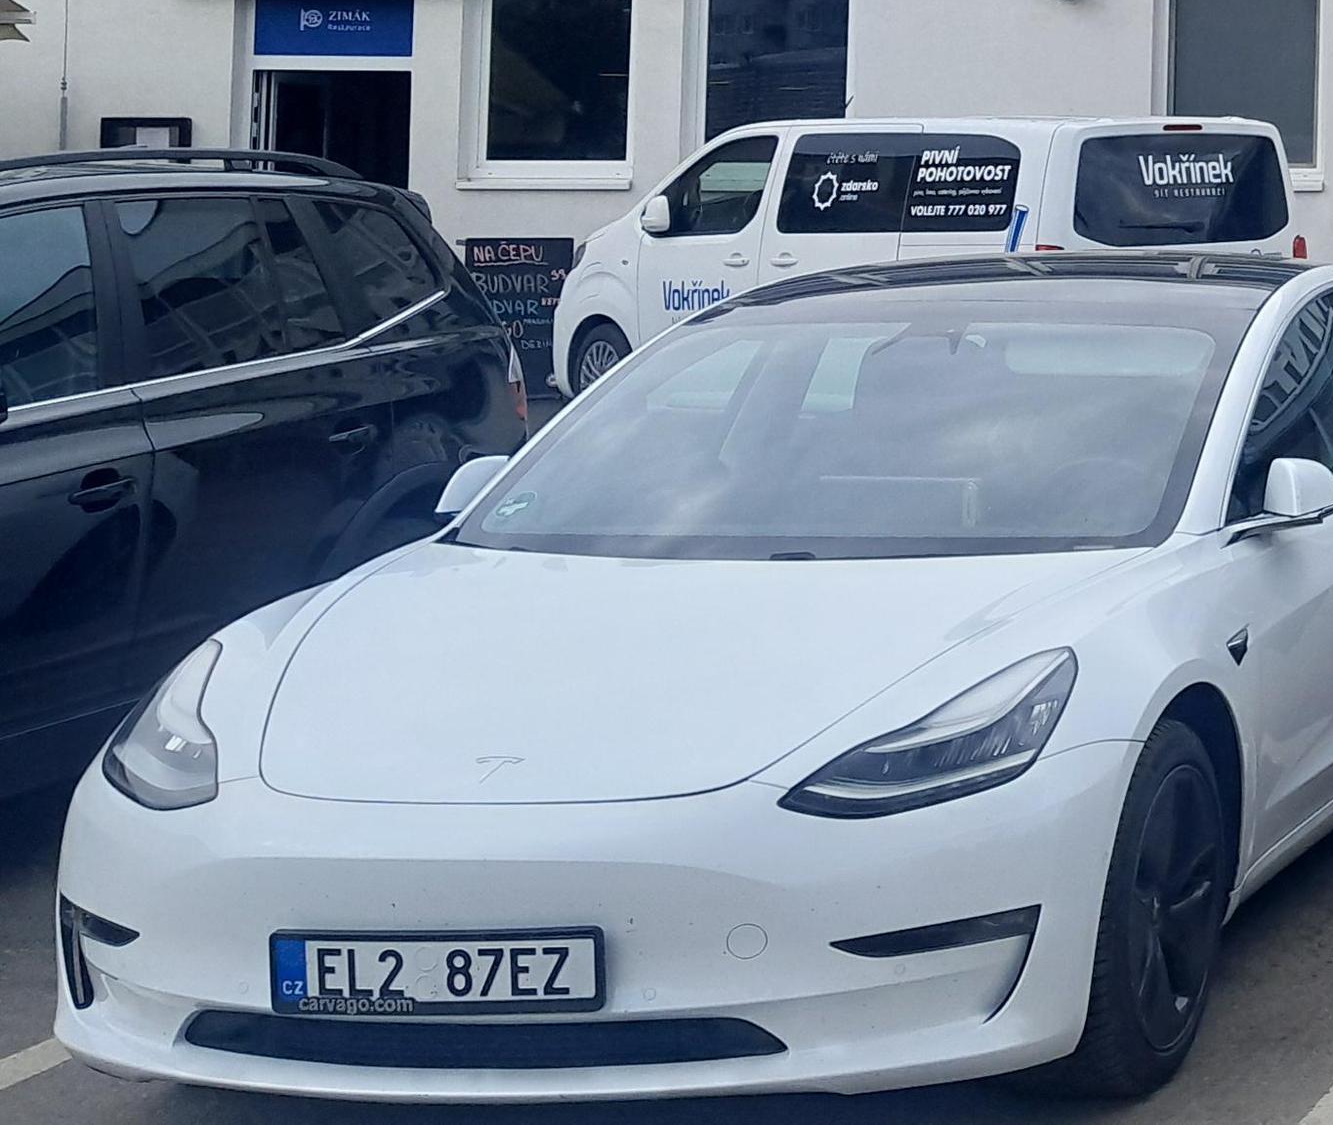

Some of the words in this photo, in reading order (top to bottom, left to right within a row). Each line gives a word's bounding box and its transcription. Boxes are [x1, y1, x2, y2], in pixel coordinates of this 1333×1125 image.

[328, 9, 371, 22] ZIMÁK
[921, 146, 960, 165] PIVNÍ
[917, 165, 1011, 182] POHOTOVOST
[1138, 153, 1234, 186] Vokřínek
[910, 205, 946, 216] VOLEJTE
[948, 204, 966, 216] 777
[967, 204, 986, 216] 020
[988, 204, 1007, 215] 977
[473, 245, 495, 262] NA
[500, 241, 544, 262] ČEPU
[473, 272, 549, 294] BUDVAR
[662, 279, 731, 311] Vokřínek
[493, 299, 539, 316] DVAR
[317, 947, 405, 997] EL2
[446, 945, 571, 998] 87EZ
[282, 981, 305, 995] CZ
[299, 996, 415, 1015] carvago.com
